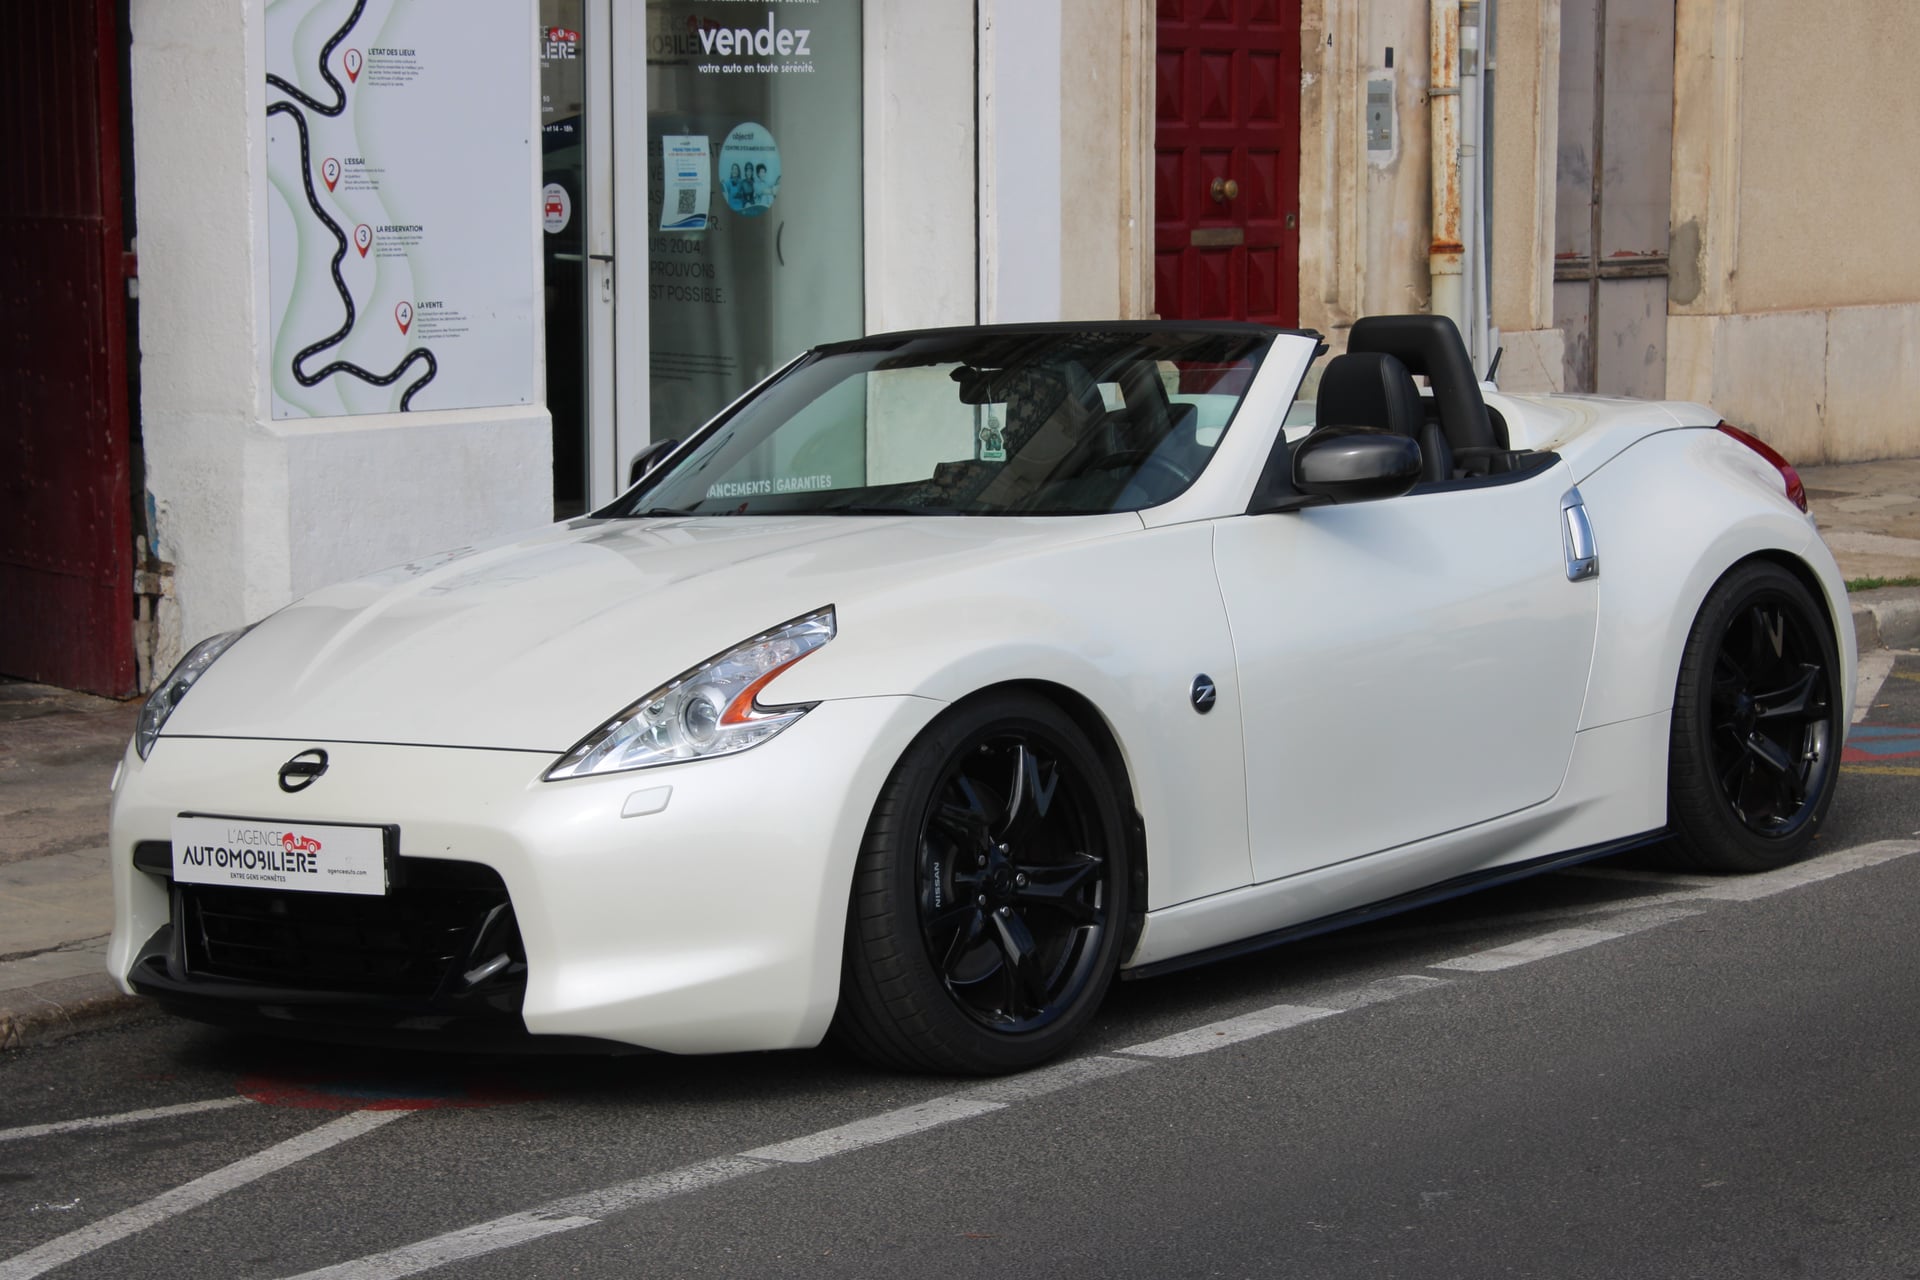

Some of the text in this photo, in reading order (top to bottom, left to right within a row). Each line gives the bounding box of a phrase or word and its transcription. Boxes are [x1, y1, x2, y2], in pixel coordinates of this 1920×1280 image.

[698, 11, 811, 56] vendez
[1327, 32, 1333, 47] 4
[399, 49, 416, 57] LIEUX
[351, 54, 355, 67] 1
[699, 63, 721, 73] votre
[722, 63, 742, 73] auto
[756, 63, 779, 73] toute
[781, 61, 816, 74] sérénité.
[328, 163, 335, 176] 2
[360, 229, 367, 242] 3
[425, 301, 443, 309] VENTE
[401, 308, 408, 319] 4
[776, 475, 832, 492] GARANTIES
[227, 828, 283, 848] L'AGENCE
[183, 846, 318, 873] AUTOMOBILIERE
[230, 872, 246, 880] ENTRE
[260, 873, 286, 883] HONNÊTES
[327, 868, 368, 876] agenceauto.com
